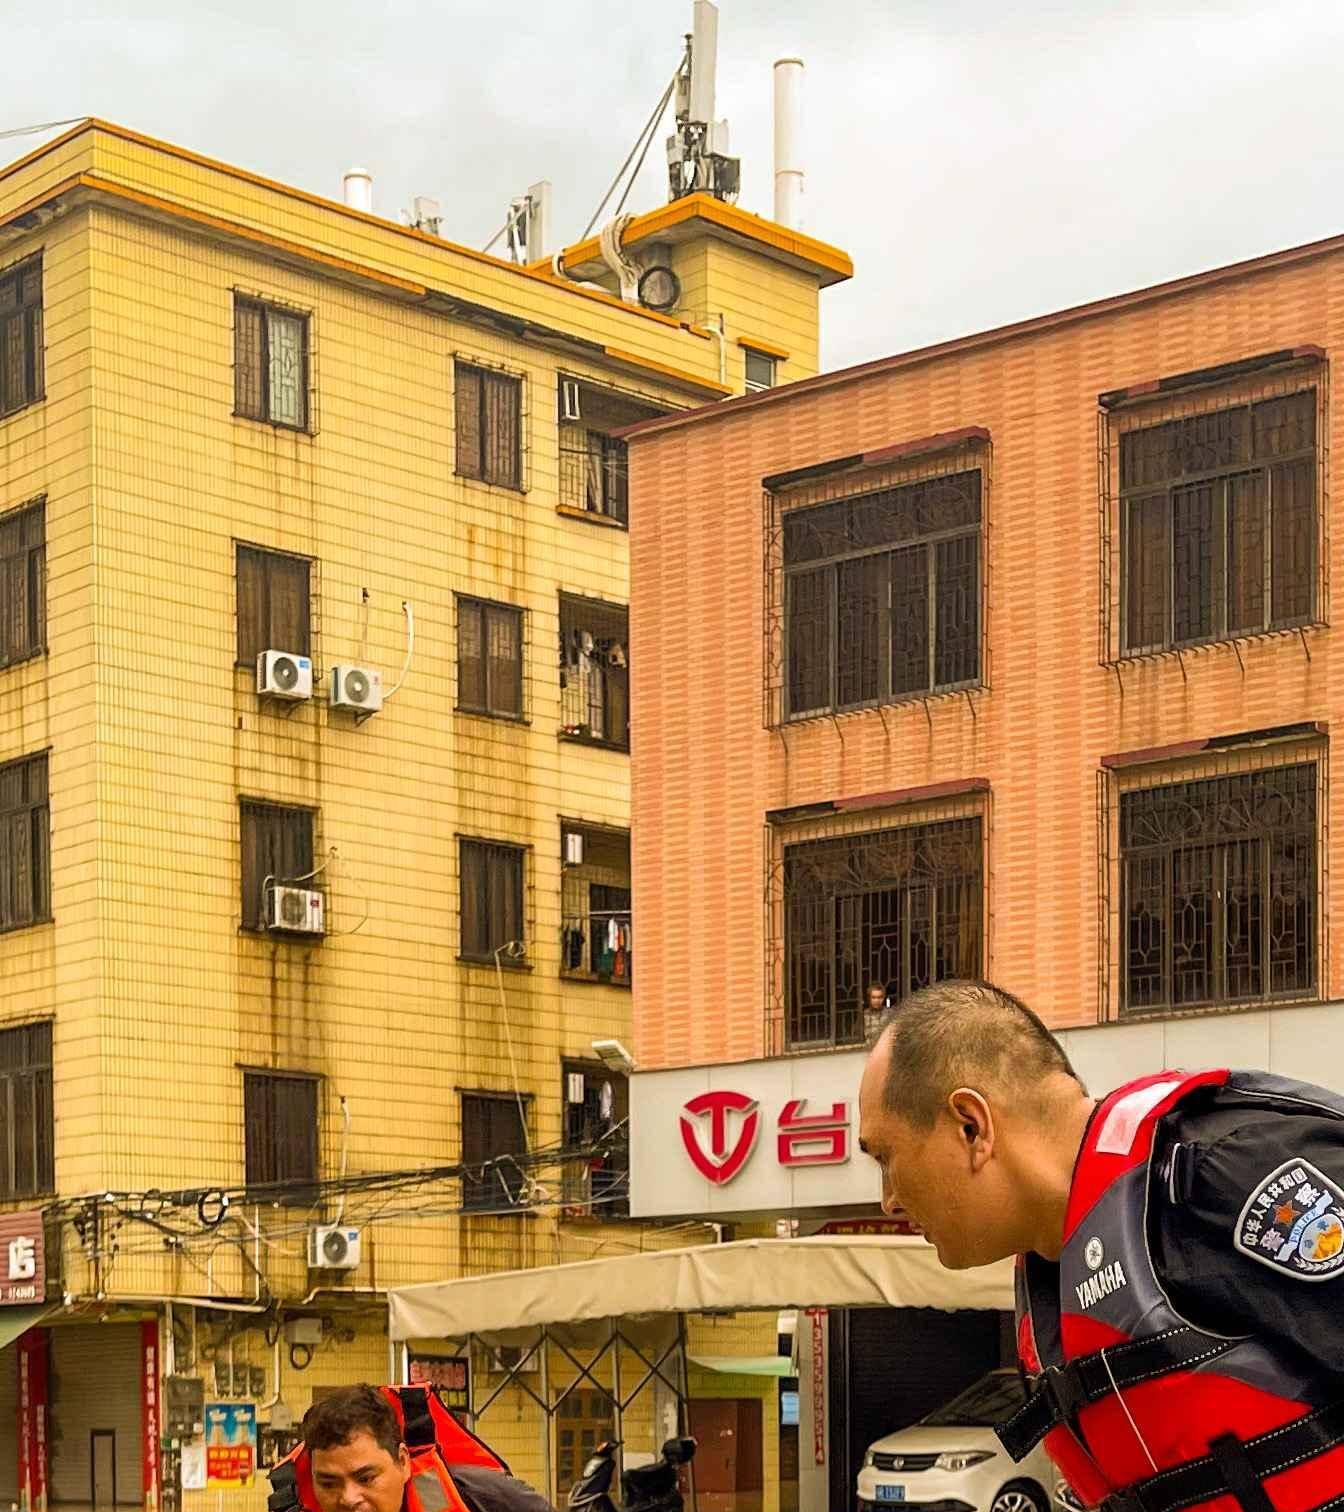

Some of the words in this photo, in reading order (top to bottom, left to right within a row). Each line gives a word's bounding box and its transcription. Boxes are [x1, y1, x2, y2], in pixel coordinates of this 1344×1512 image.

[1243, 1167, 1308, 1246] 中华人民共和国
[1076, 1261, 1127, 1310] YAMAHA
